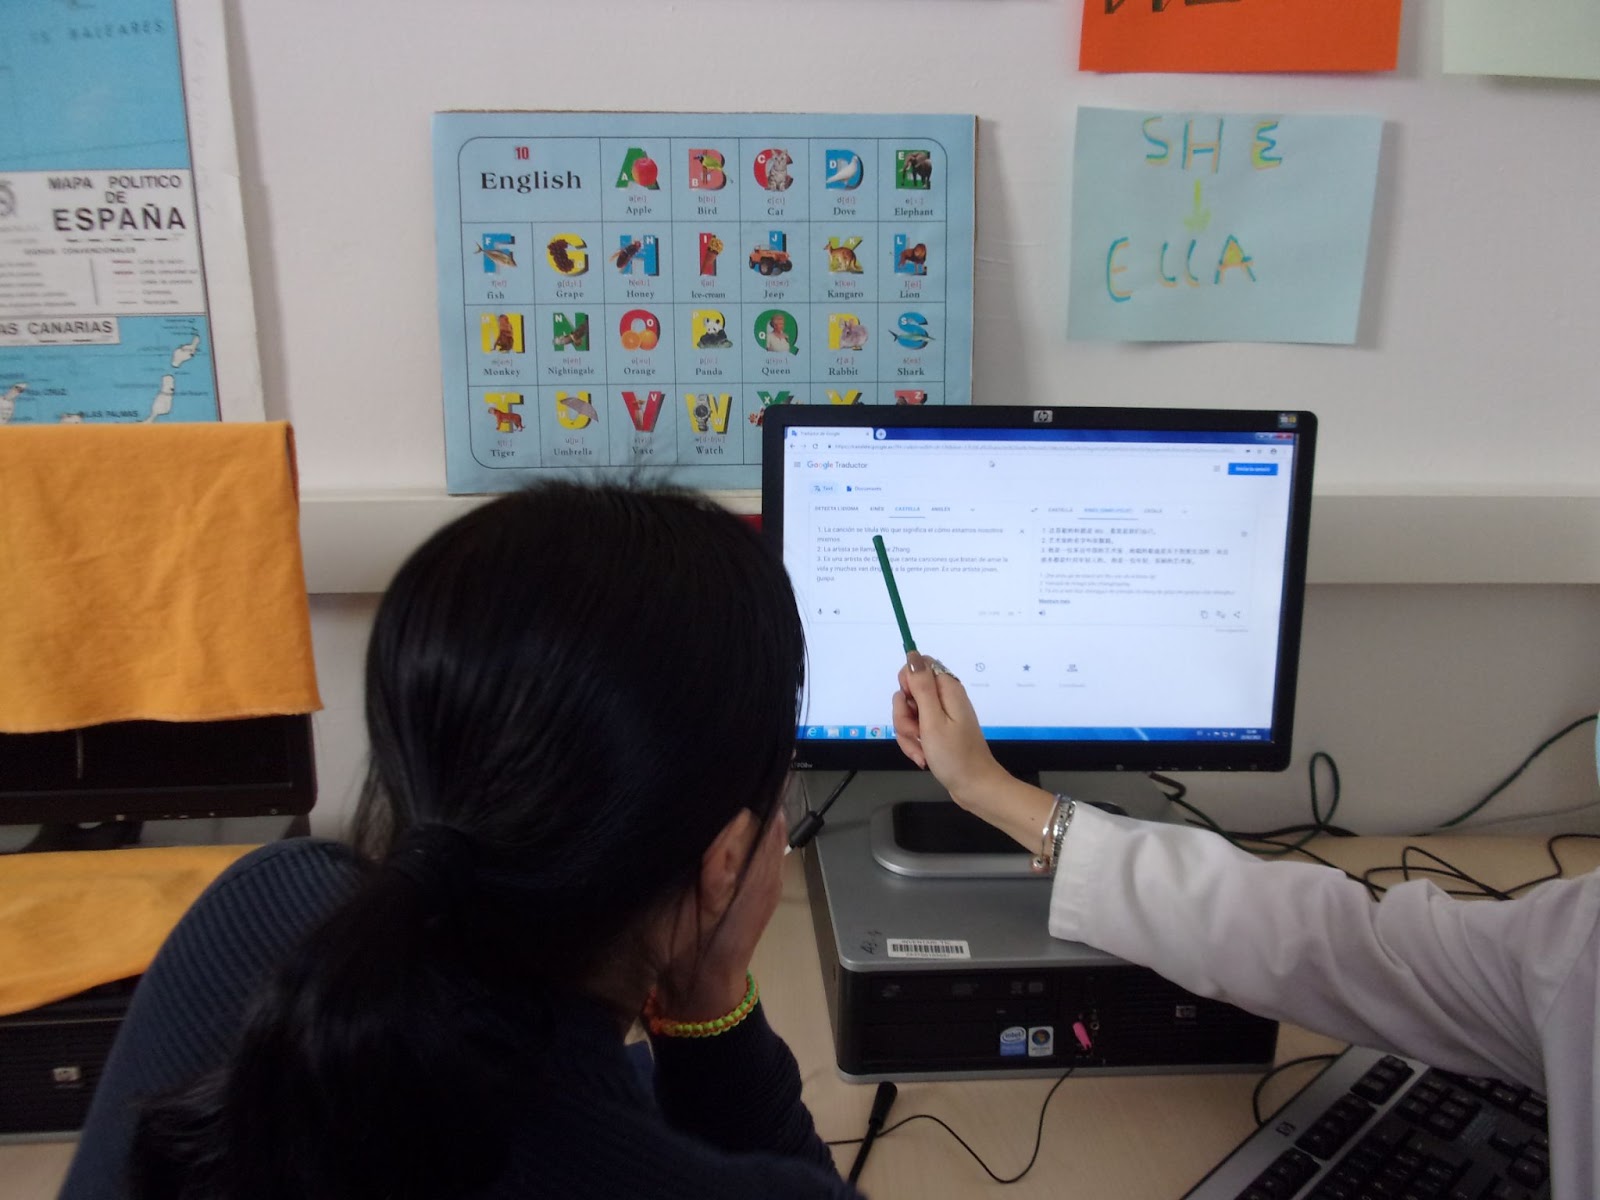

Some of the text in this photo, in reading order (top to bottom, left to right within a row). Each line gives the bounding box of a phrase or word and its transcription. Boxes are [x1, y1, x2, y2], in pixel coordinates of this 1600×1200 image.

[1141, 115, 1283, 174] SHE
[514, 146, 530, 160] 10
[48, 174, 182, 190] MAPA POLITICO
[480, 171, 582, 194] English
[106, 190, 127, 204] DE
[626, 205, 652, 215] Apple
[698, 206, 718, 215] Bird
[767, 207, 784, 216] Cat
[832, 207, 856, 216] Dove
[894, 207, 934, 217] Elephant
[52, 202, 187, 232] ESPAÑA
[486, 290, 505, 300] fish
[556, 289, 584, 300] Grape
[626, 289, 655, 300] Honey
[691, 290, 726, 299] Ice-cream
[763, 290, 784, 300] Jeep
[827, 290, 864, 300] Kangaro
[900, 290, 920, 299] Lion
[27, 320, 114, 335] CANARIAS
[484, 368, 520, 376] Monkey
[548, 366, 594, 376] Nightingale
[624, 367, 656, 376] Orange
[695, 368, 723, 376] Panda
[761, 366, 791, 376] Queen
[828, 367, 858, 376] Rabbit
[896, 367, 925, 376] Shark
[490, 449, 516, 458] Tiger
[554, 448, 593, 456] Umbrella
[696, 446, 724, 454] Watch
[807, 460, 868, 470] Google Traductor
